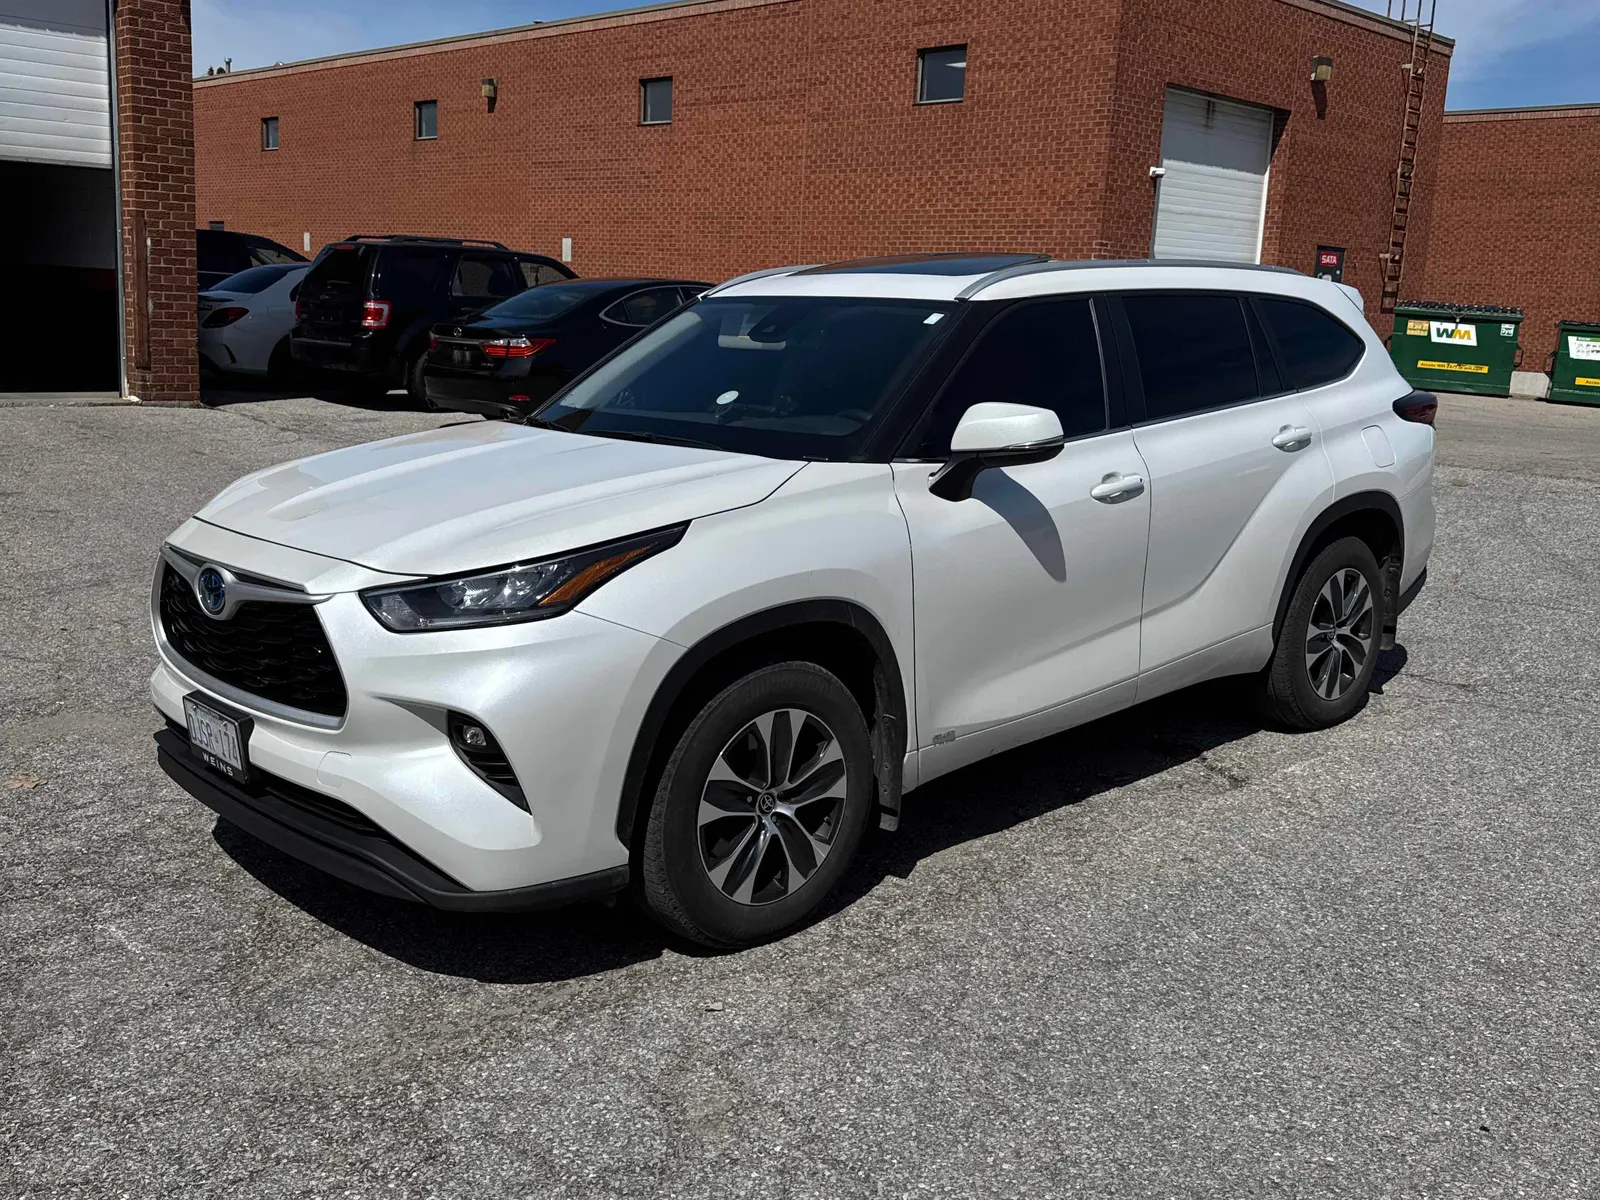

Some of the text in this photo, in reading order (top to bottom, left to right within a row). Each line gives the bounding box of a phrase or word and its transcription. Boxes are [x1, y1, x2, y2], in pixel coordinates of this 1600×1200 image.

[1321, 255, 1337, 265] SATA
[1436, 327, 1471, 340] WM
[202, 752, 233, 777] WEINS
